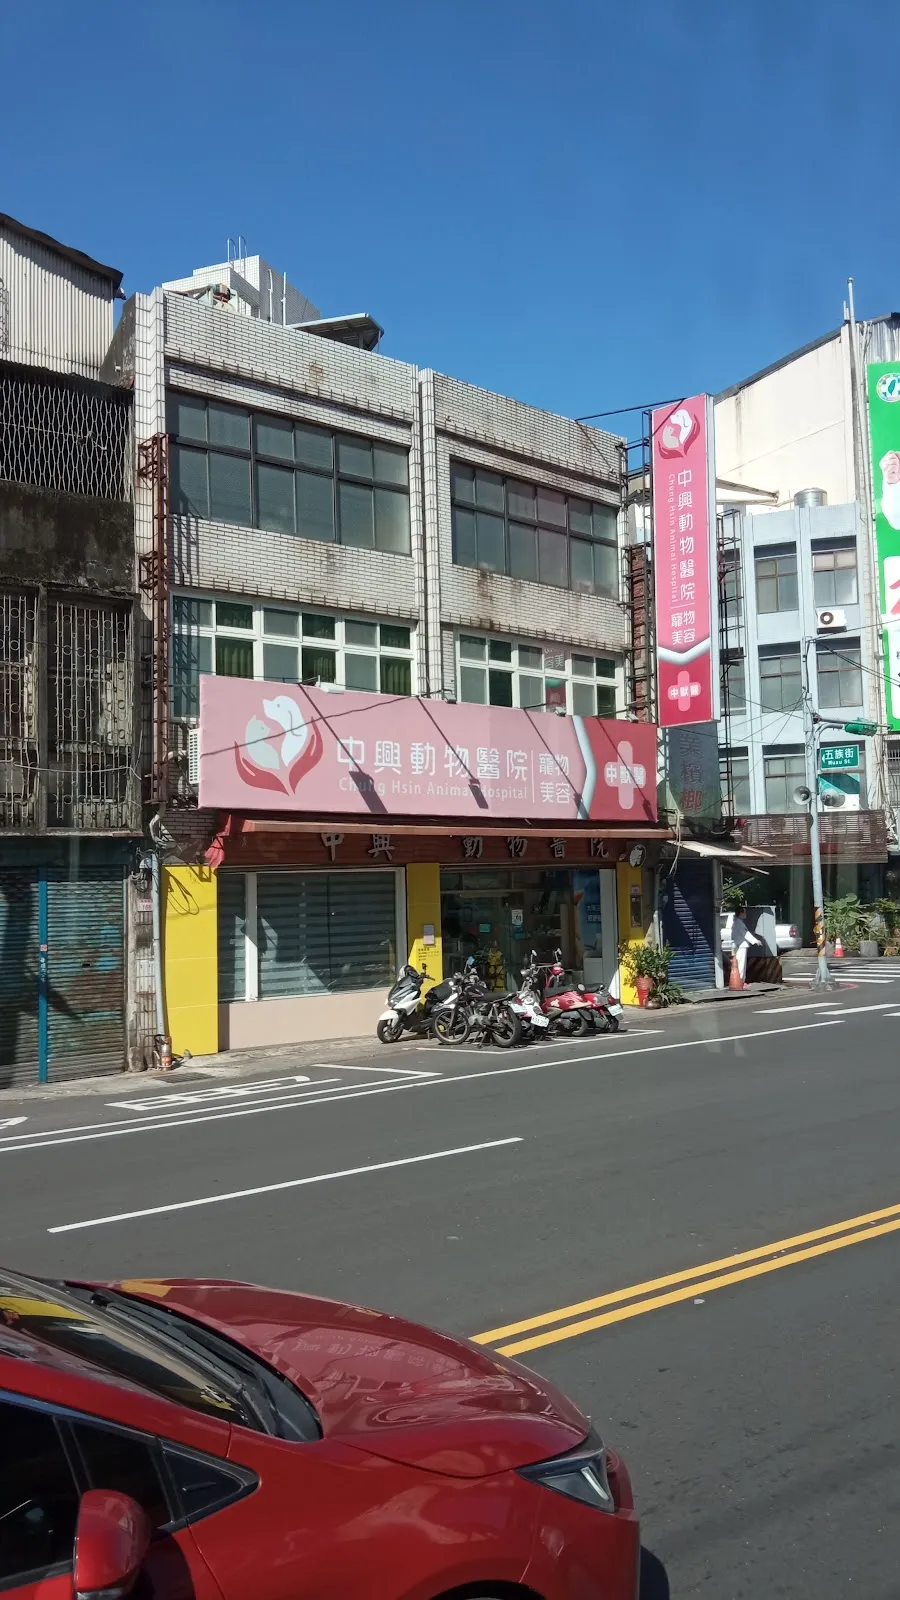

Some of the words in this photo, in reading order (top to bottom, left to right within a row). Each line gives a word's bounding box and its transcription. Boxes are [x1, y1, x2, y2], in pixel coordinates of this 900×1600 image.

[668, 473, 676, 503] Chung
[669, 528, 677, 561] Animal
[677, 469, 695, 600] 中興動物醫院
[671, 610, 695, 627] 寵物
[672, 628, 696, 645] 美容
[670, 684, 699, 698] 中獸醫
[336, 736, 528, 781] 中興動物醫院
[539, 753, 569, 777] 寵物
[825, 748, 854, 760] 五族街
[606, 765, 645, 785] 中獸醫
[339, 776, 386, 796] Chung
[392, 780, 421, 795] Hsin
[479, 783, 528, 802] Hospital
[540, 782, 571, 804] 美容
